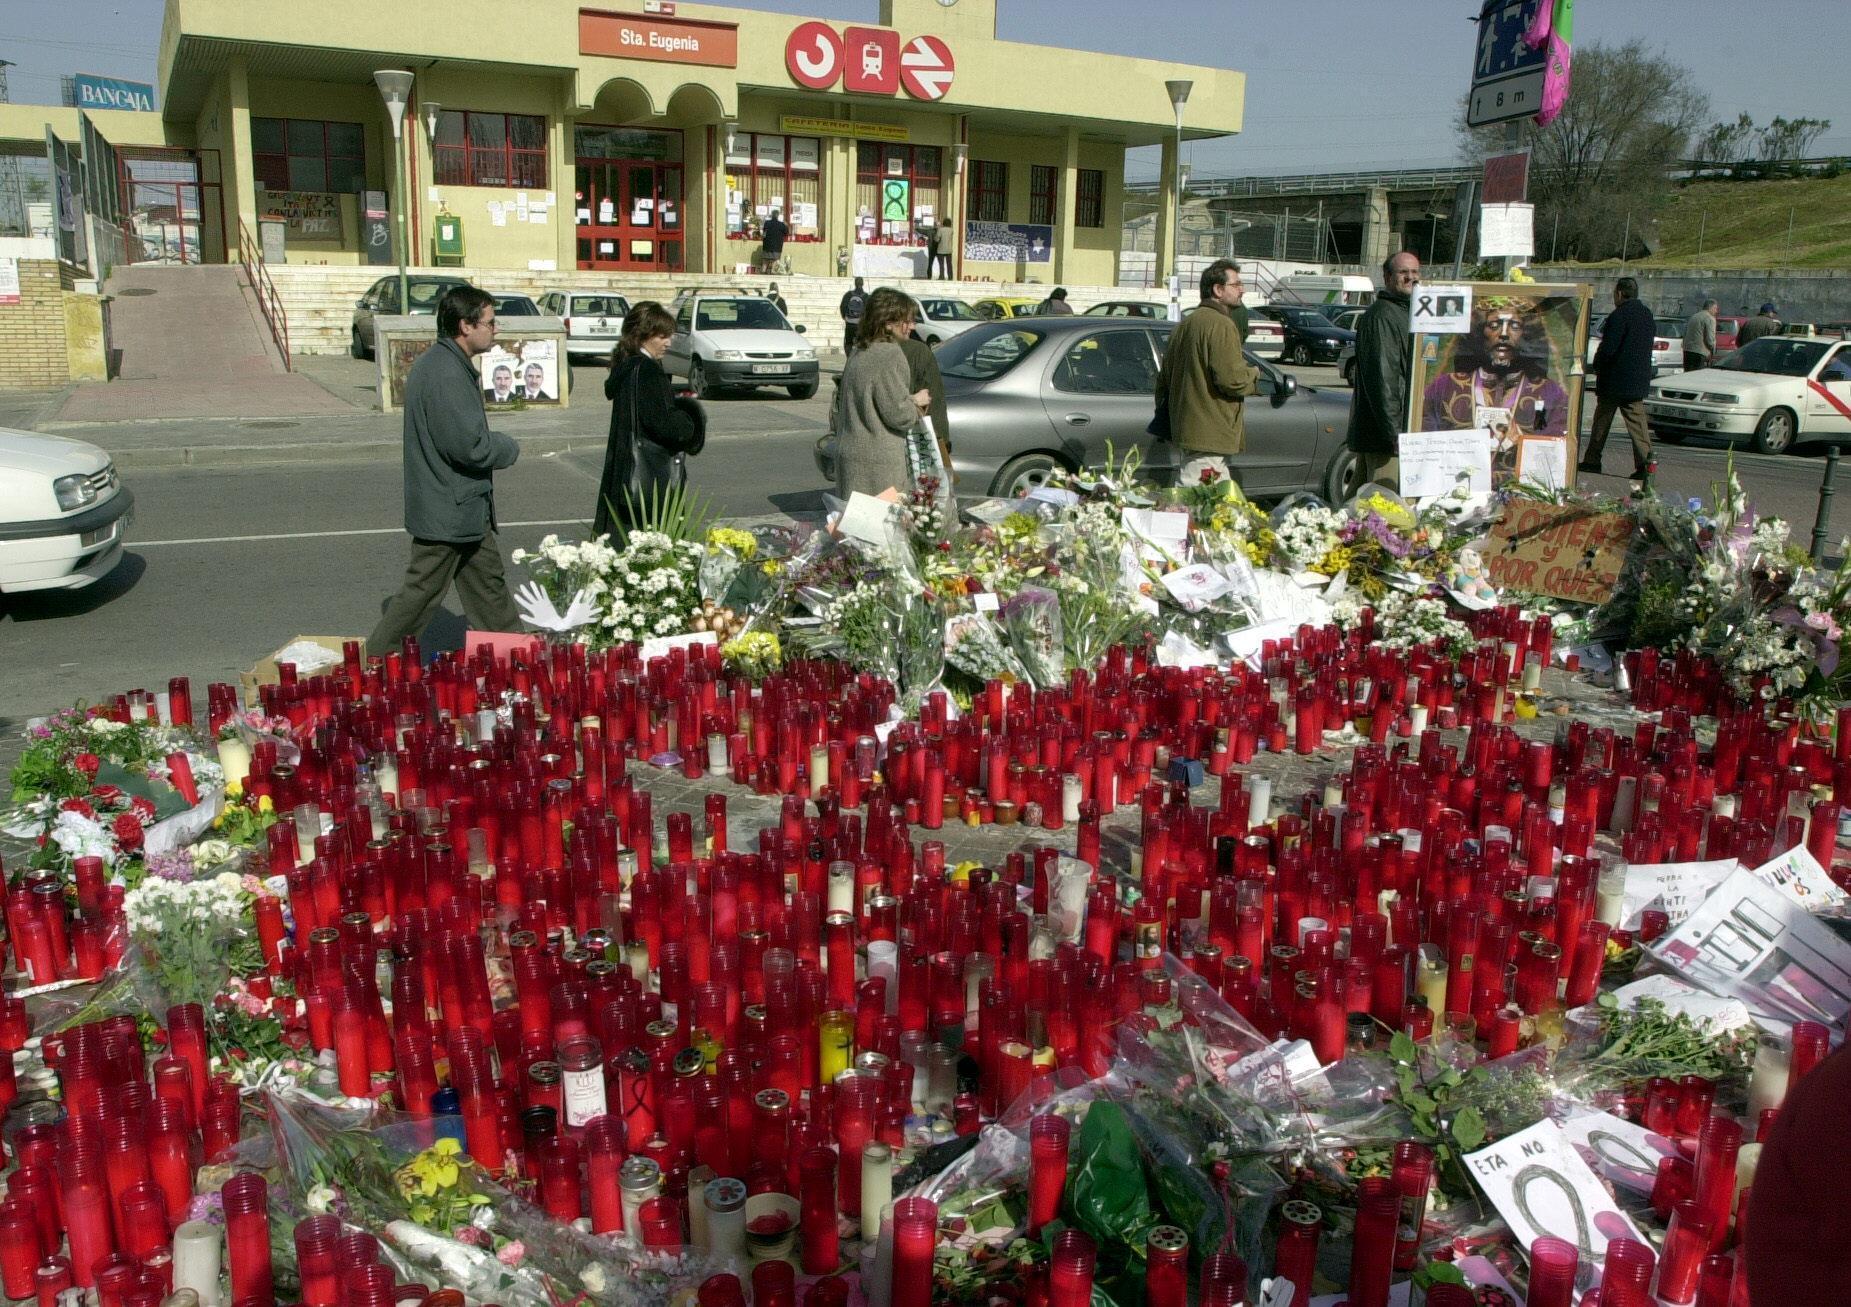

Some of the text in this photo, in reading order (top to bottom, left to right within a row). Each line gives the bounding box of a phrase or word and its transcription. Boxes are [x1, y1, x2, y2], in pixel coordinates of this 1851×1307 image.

[620, 28, 699, 52] Sta. Eugenia
[81, 84, 151, 112] BANCAJA
[1496, 91, 1524, 107] 8 m
[1489, 554, 1539, 588] POR
[1473, 1140, 1546, 1176] ETA NO
